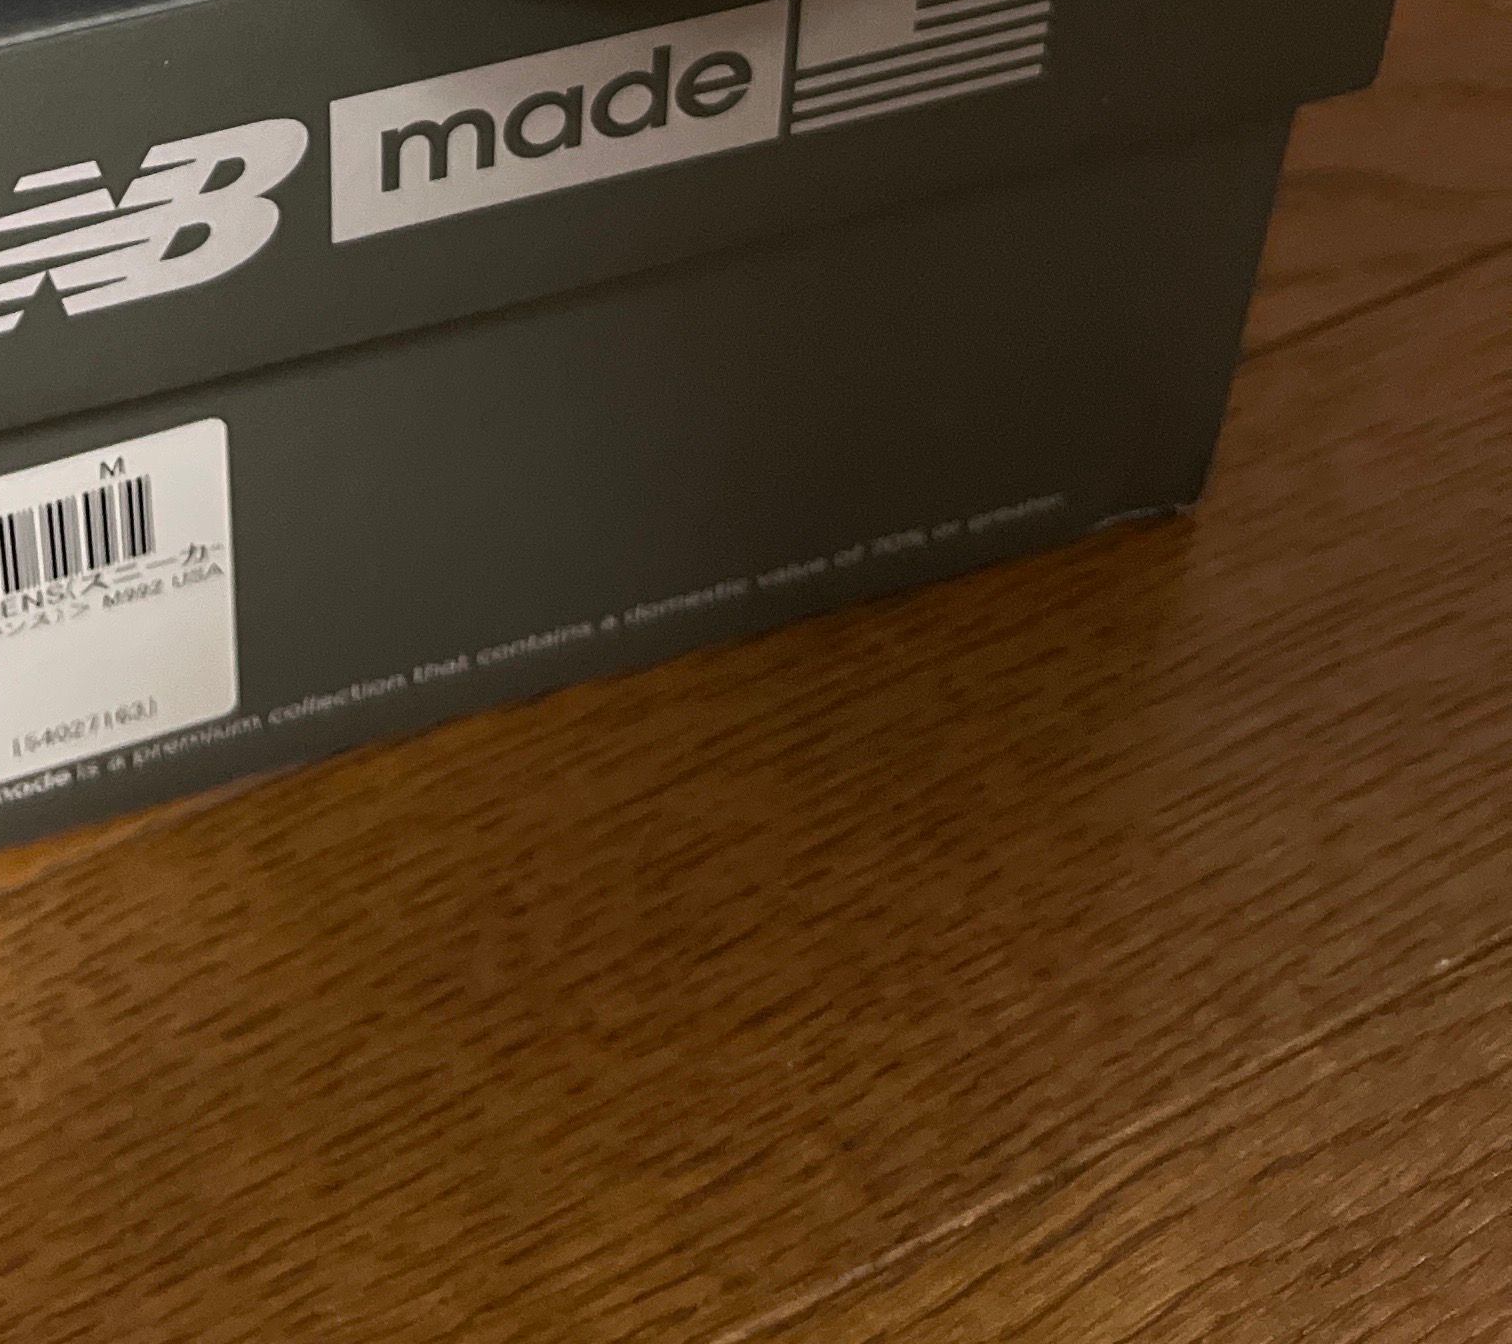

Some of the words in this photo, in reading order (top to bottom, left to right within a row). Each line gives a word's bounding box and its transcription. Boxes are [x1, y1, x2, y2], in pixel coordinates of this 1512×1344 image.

[380, 44, 752, 193] made
[99, 455, 126, 480] M
[172, 561, 224, 588] USA
[76, 761, 100, 782] is
[132, 715, 263, 769] premium
[267, 673, 407, 725] collection
[412, 653, 469, 684] that
[475, 622, 592, 665] contains
[623, 576, 749, 627] domestic
